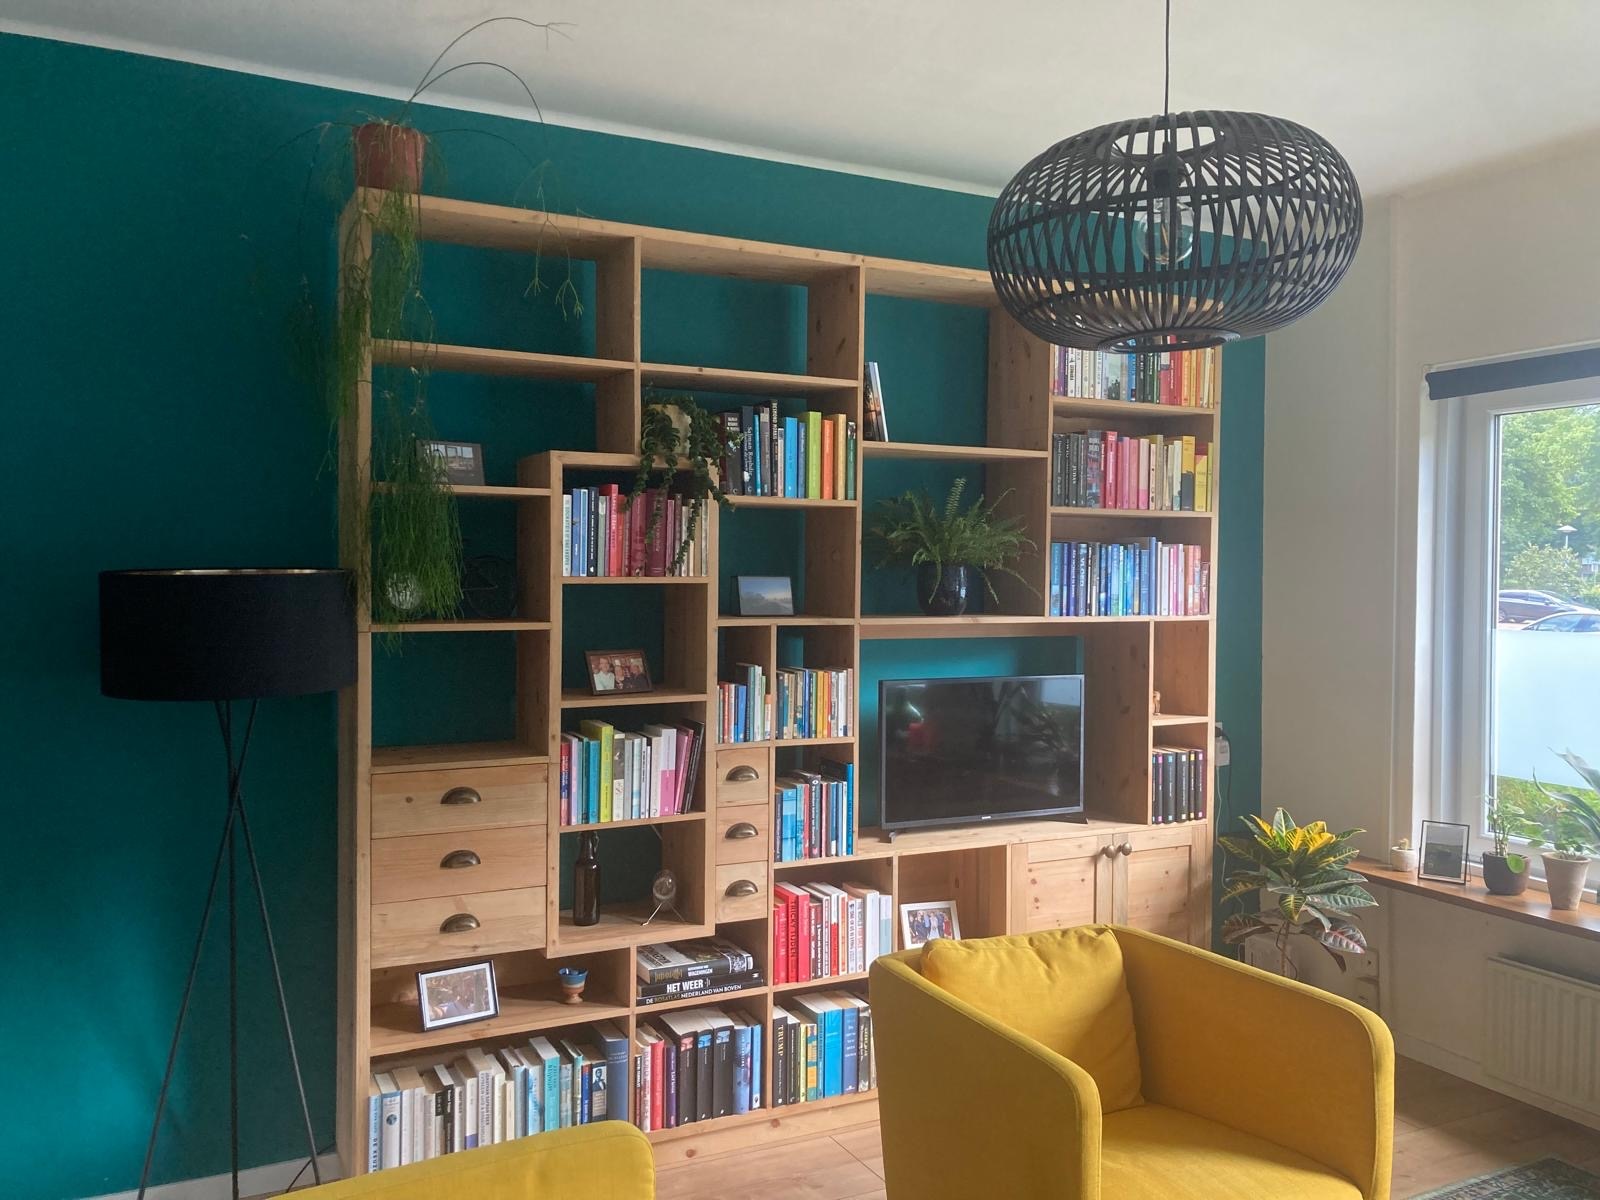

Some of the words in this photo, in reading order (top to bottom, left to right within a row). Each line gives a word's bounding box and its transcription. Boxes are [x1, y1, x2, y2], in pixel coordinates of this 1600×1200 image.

[667, 983, 681, 993] HET
[682, 979, 704, 990] WEER
[681, 988, 713, 998] NEDERLAND
[712, 986, 723, 994] VAN
[724, 984, 742, 992] BOVEN
